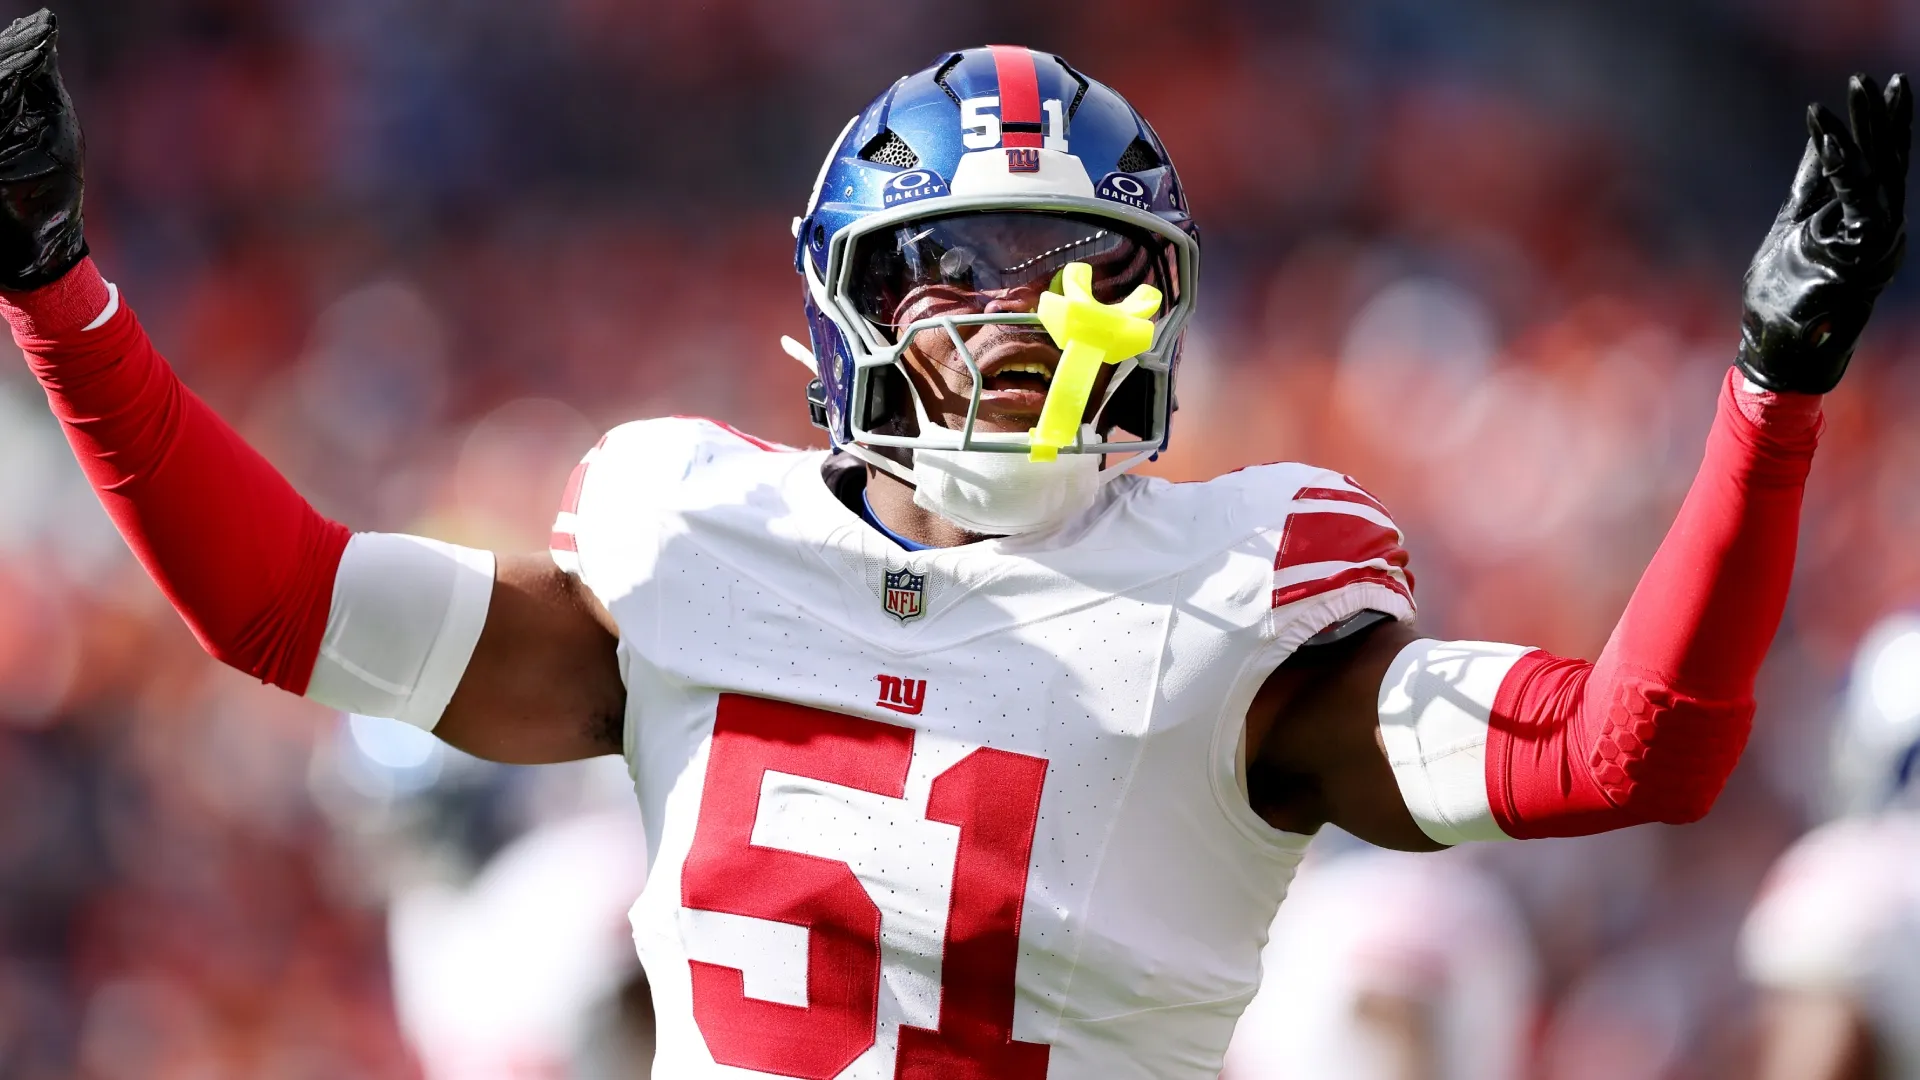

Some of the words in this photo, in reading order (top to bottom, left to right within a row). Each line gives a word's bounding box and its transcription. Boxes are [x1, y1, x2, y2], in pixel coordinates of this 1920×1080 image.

[886, 185, 941, 202] OAKLEY
[1103, 188, 1149, 210] OAKLEY
[887, 589, 918, 614] NFL
[681, 692, 1050, 1080] 51
